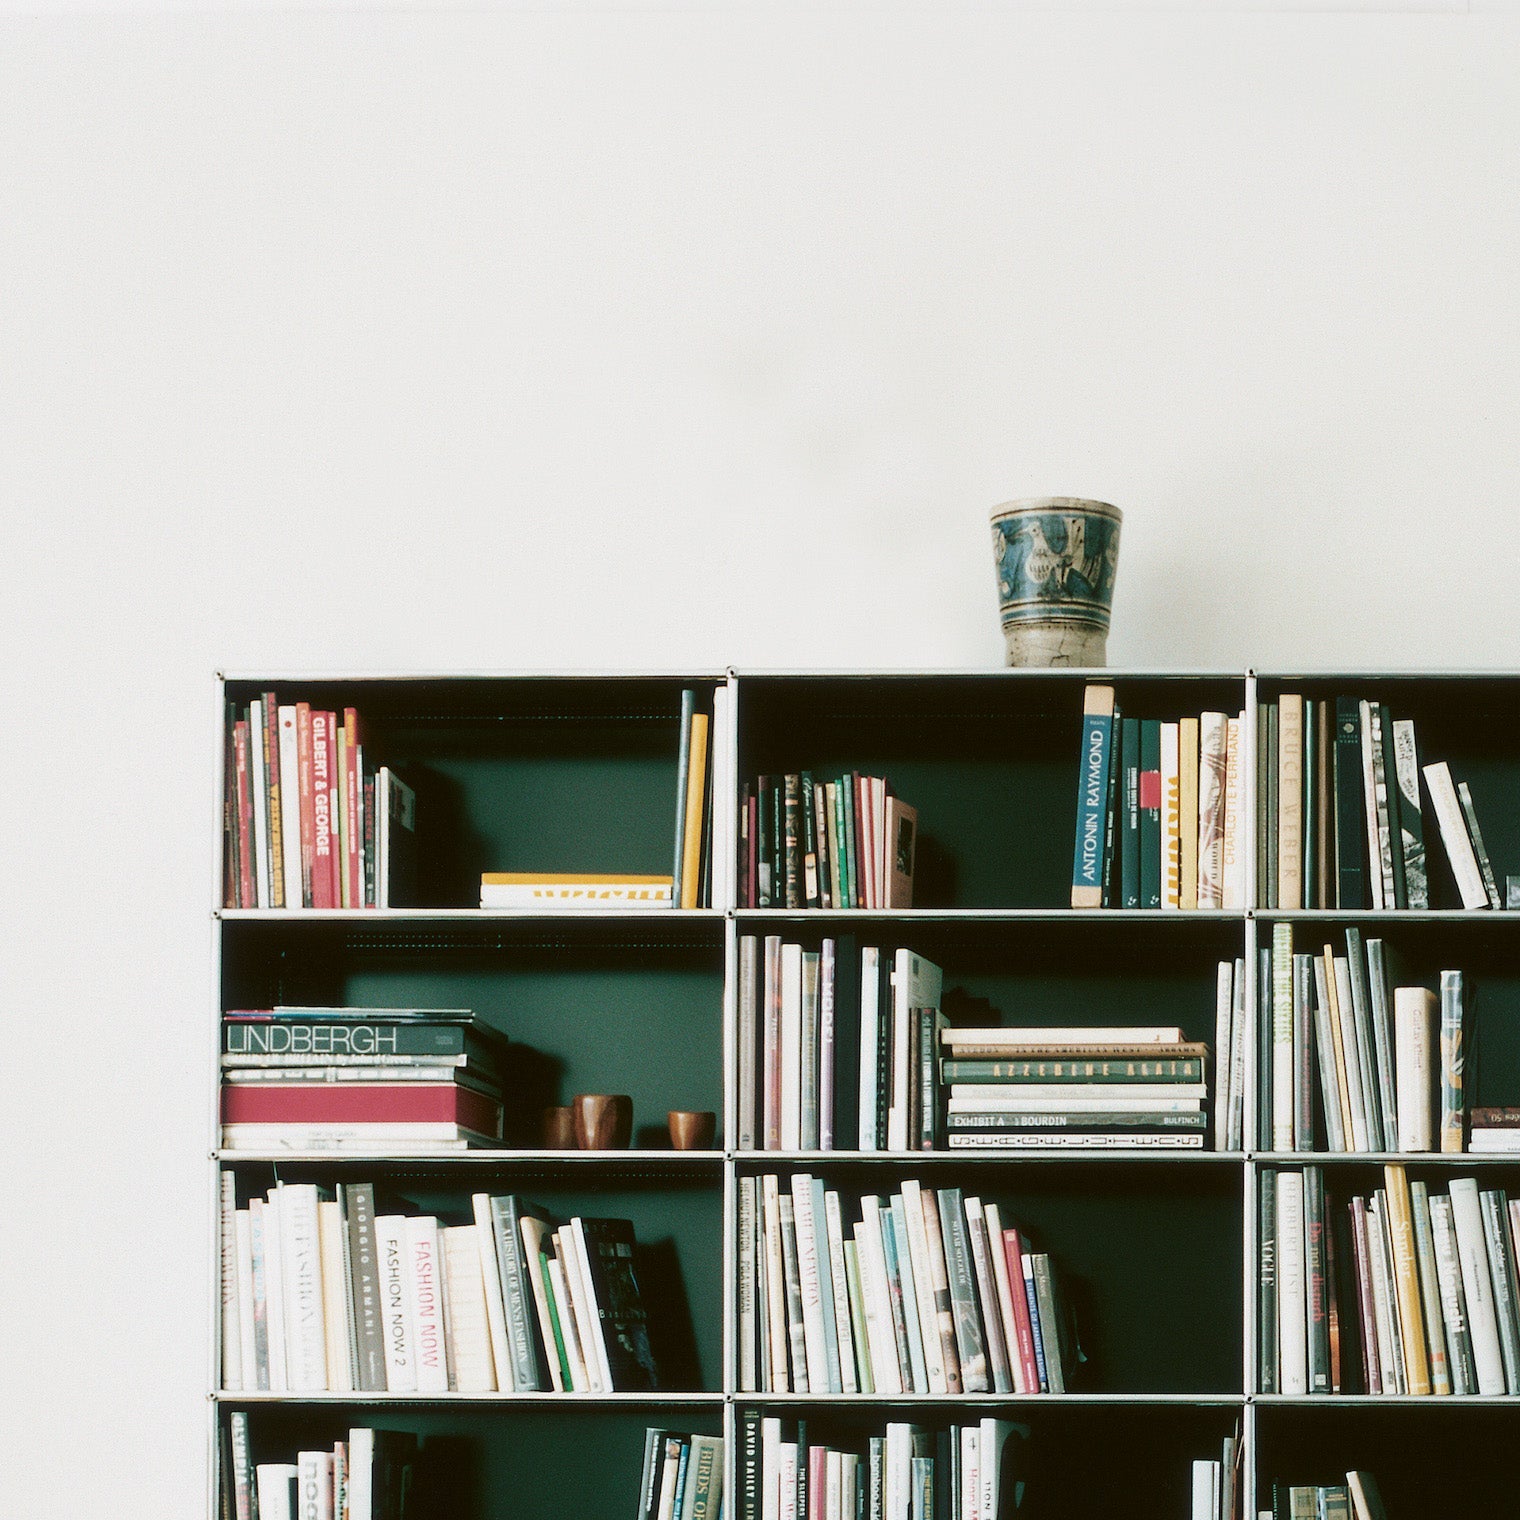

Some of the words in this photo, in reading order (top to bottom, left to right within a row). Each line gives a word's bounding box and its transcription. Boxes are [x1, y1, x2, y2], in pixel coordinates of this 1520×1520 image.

[312, 717, 328, 779] GILBERT
[1086, 730, 1104, 806] RAYMOND
[1226, 724, 1239, 788] PERRIAND
[1284, 711, 1298, 784] BRUCE
[315, 794, 330, 857] GEORGE
[1083, 814, 1099, 880] ANTONIN
[1224, 791, 1238, 864] CHARLOTTE
[1284, 804, 1297, 878] WEBER
[226, 1025, 397, 1054] LINDBERGH
[1412, 1009, 1422, 1041] Gustav
[1414, 1044, 1423, 1069] Klimt
[953, 1116, 995, 1126] EXHIBIT
[997, 1116, 1006, 1126] A
[1021, 1116, 1068, 1126] BOURDIN
[1163, 1116, 1200, 1125] BULFINCH
[1491, 1113, 1503, 1122] 50
[951, 1221, 959, 1231] SO
[1310, 1222, 1323, 1243] Do
[356, 1195, 370, 1264] GIORGIO
[363, 1275, 375, 1337] ARMANI
[1260, 1238, 1275, 1288] VOGUE
[1310, 1246, 1322, 1269] not
[1398, 1220, 1413, 1278] Sander
[386, 1239, 402, 1308] FASHION
[415, 1240, 435, 1317] FASHION
[1311, 1272, 1325, 1323] disturb
[1441, 1260, 1465, 1332] Noguchi
[392, 1313, 405, 1354] NOW
[421, 1323, 439, 1368] NOW
[513, 1320, 528, 1363] FASHION
[1026, 1281, 1036, 1312] ELEMENTS
[1031, 1323, 1041, 1353] JAPANESE
[1036, 1353, 1045, 1378] DESIGN
[395, 1358, 406, 1367] 2
[231, 1414, 248, 1487] OLYMPIA
[746, 1422, 756, 1456] DAVID
[697, 1450, 714, 1494] BIRDS
[745, 1460, 756, 1498] BAILEY
[799, 1467, 807, 1481] THE
[871, 1455, 882, 1501] bamboo
[966, 1468, 978, 1507] Henry
[798, 1482, 806, 1517] SLEEPERS
[984, 1480, 992, 1511] NOLL
